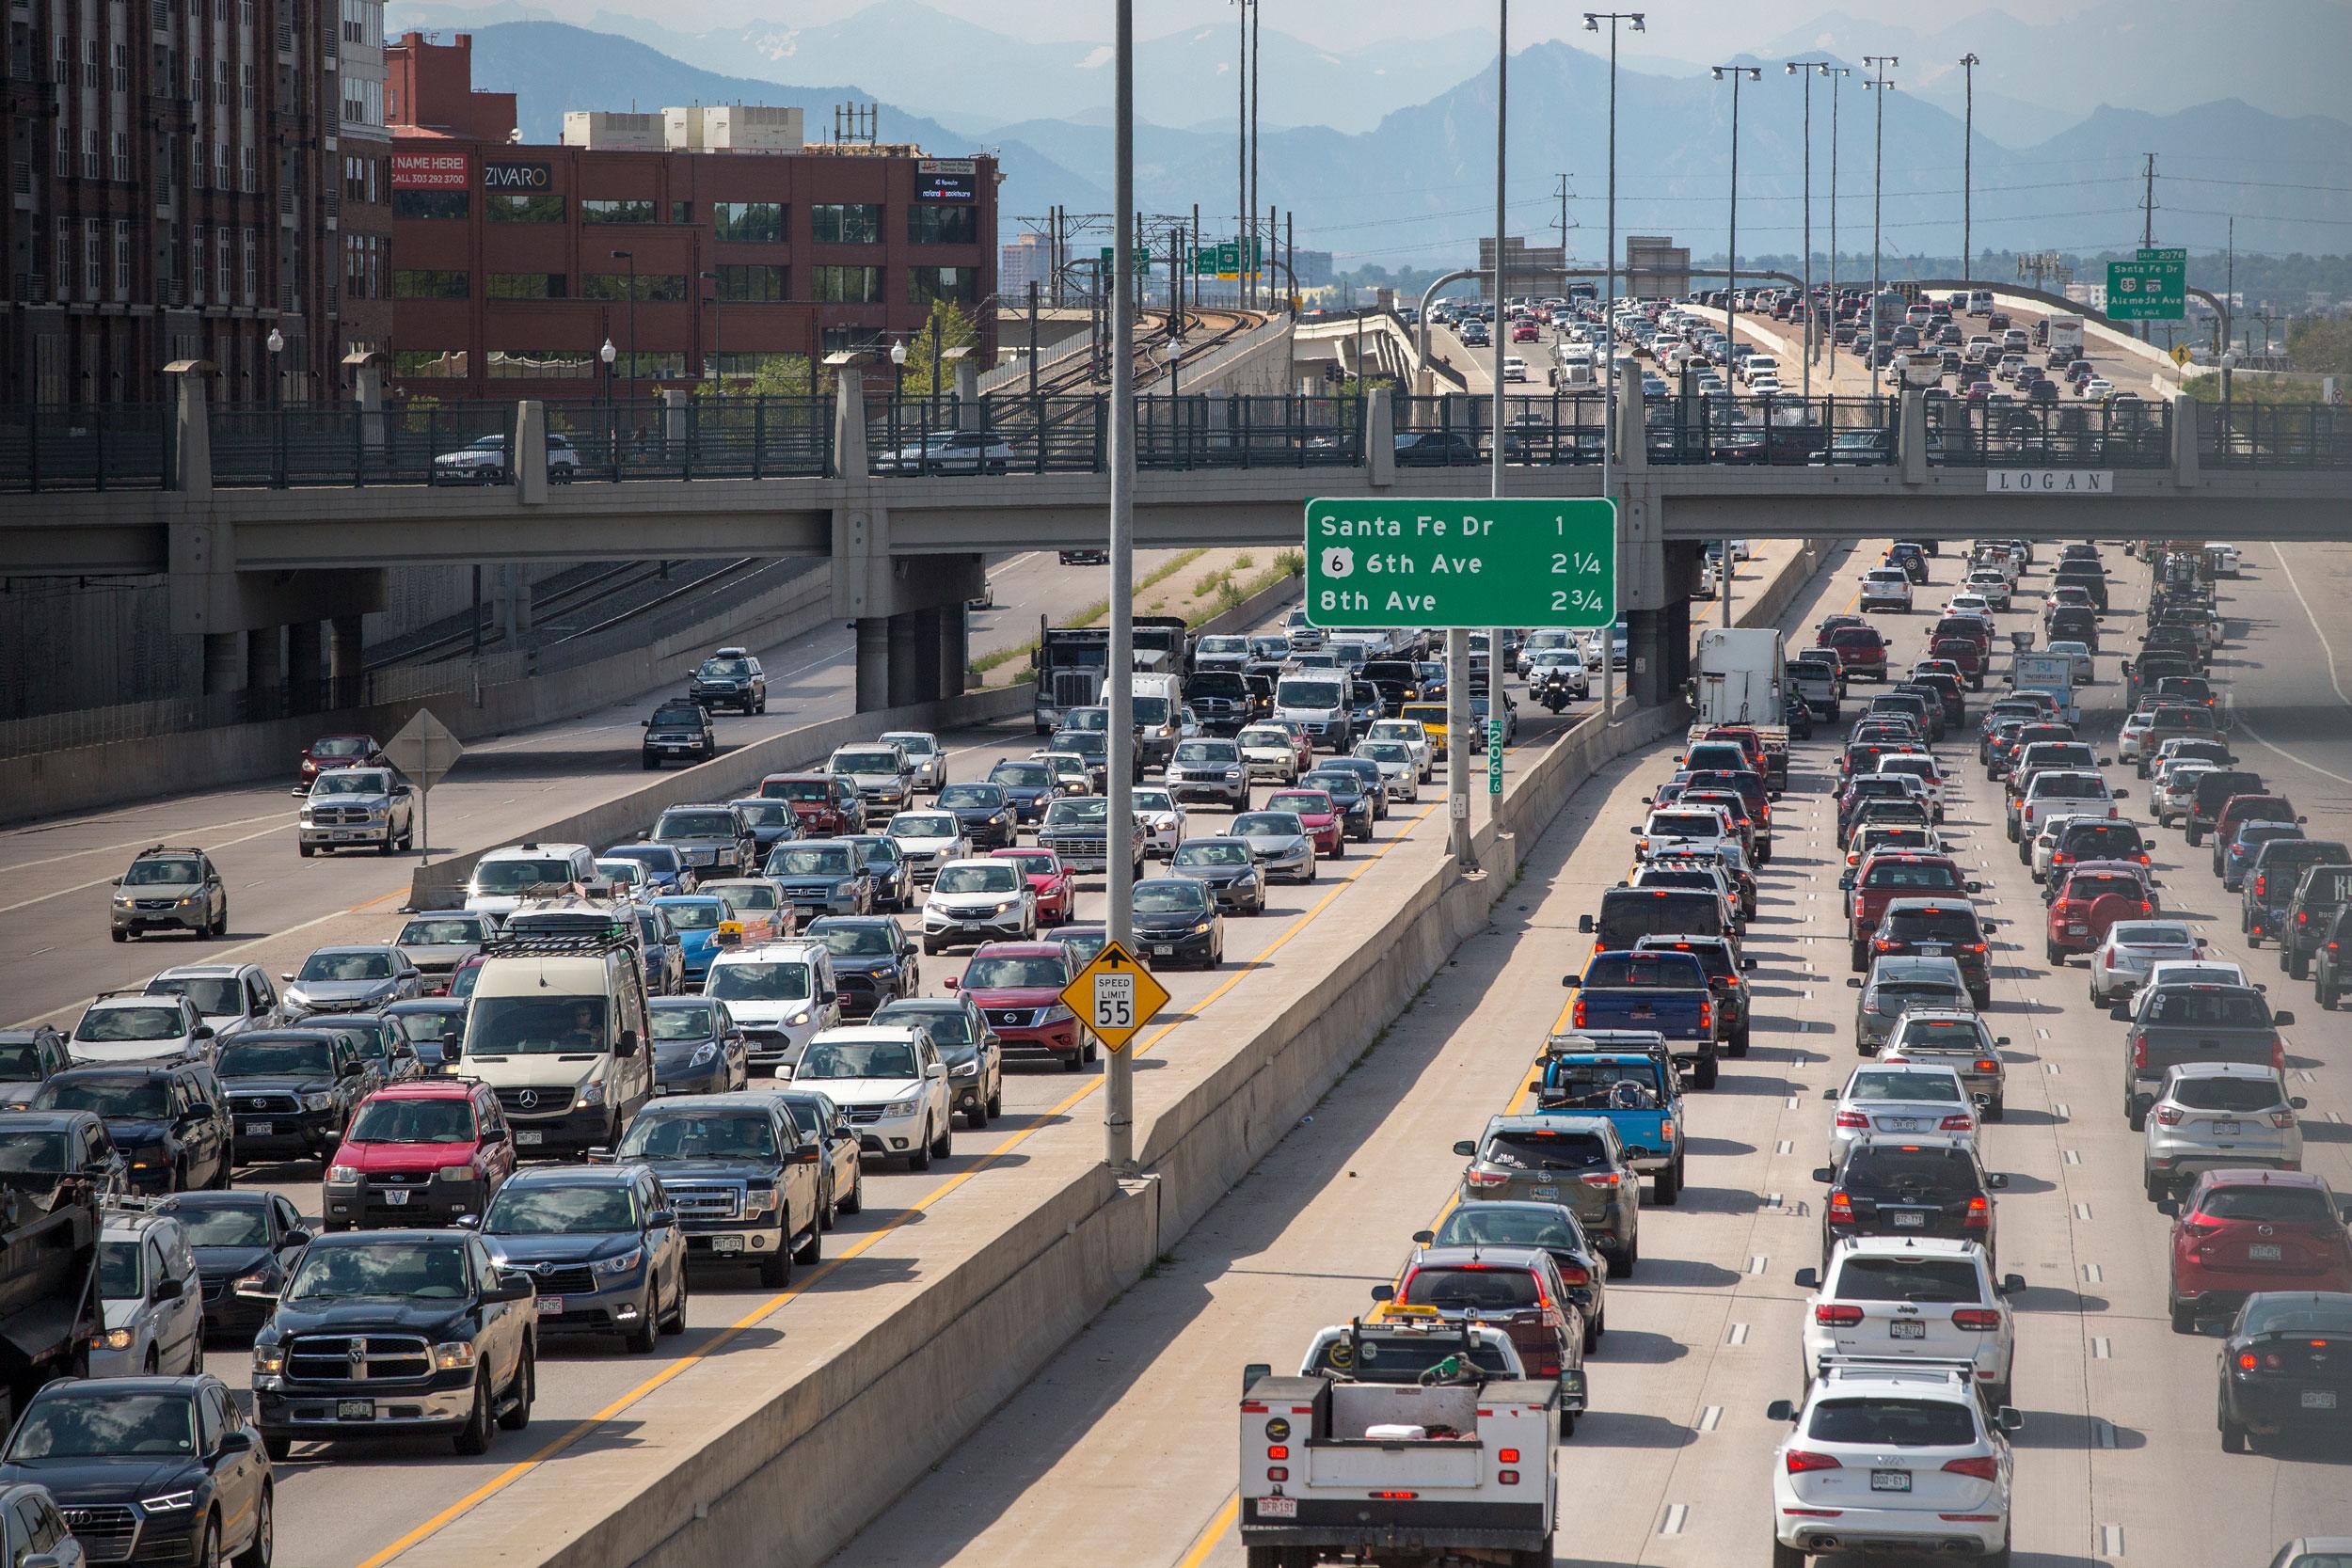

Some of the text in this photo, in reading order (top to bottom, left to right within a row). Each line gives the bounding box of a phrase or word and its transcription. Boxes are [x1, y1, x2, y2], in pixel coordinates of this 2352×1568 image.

[397, 157, 430, 169] NAME
[431, 157, 464, 170] HERE!
[412, 174, 427, 183] 303
[428, 174, 443, 183] 292
[444, 174, 465, 184] 3700
[485, 166, 547, 186] ZIVARO
[2114, 264, 2178, 273] Santa Fe Dr
[2110, 295, 2182, 305] Alameda Ave
[2000, 472, 2100, 490] LOGAN
[1320, 515, 1564, 536] Santa Fe Dr 1
[1331, 554, 1343, 572] 6
[1366, 553, 1414, 574] 6th
[1430, 554, 1483, 574] Ave
[1320, 591, 1369, 611] 8th
[1385, 591, 1437, 611] Ave
[1098, 978, 1130, 988] SPEED
[1101, 990, 1127, 999] LIMIT
[1099, 1000, 1130, 1025] 55
[1897, 1305, 1918, 1315] Jeep
